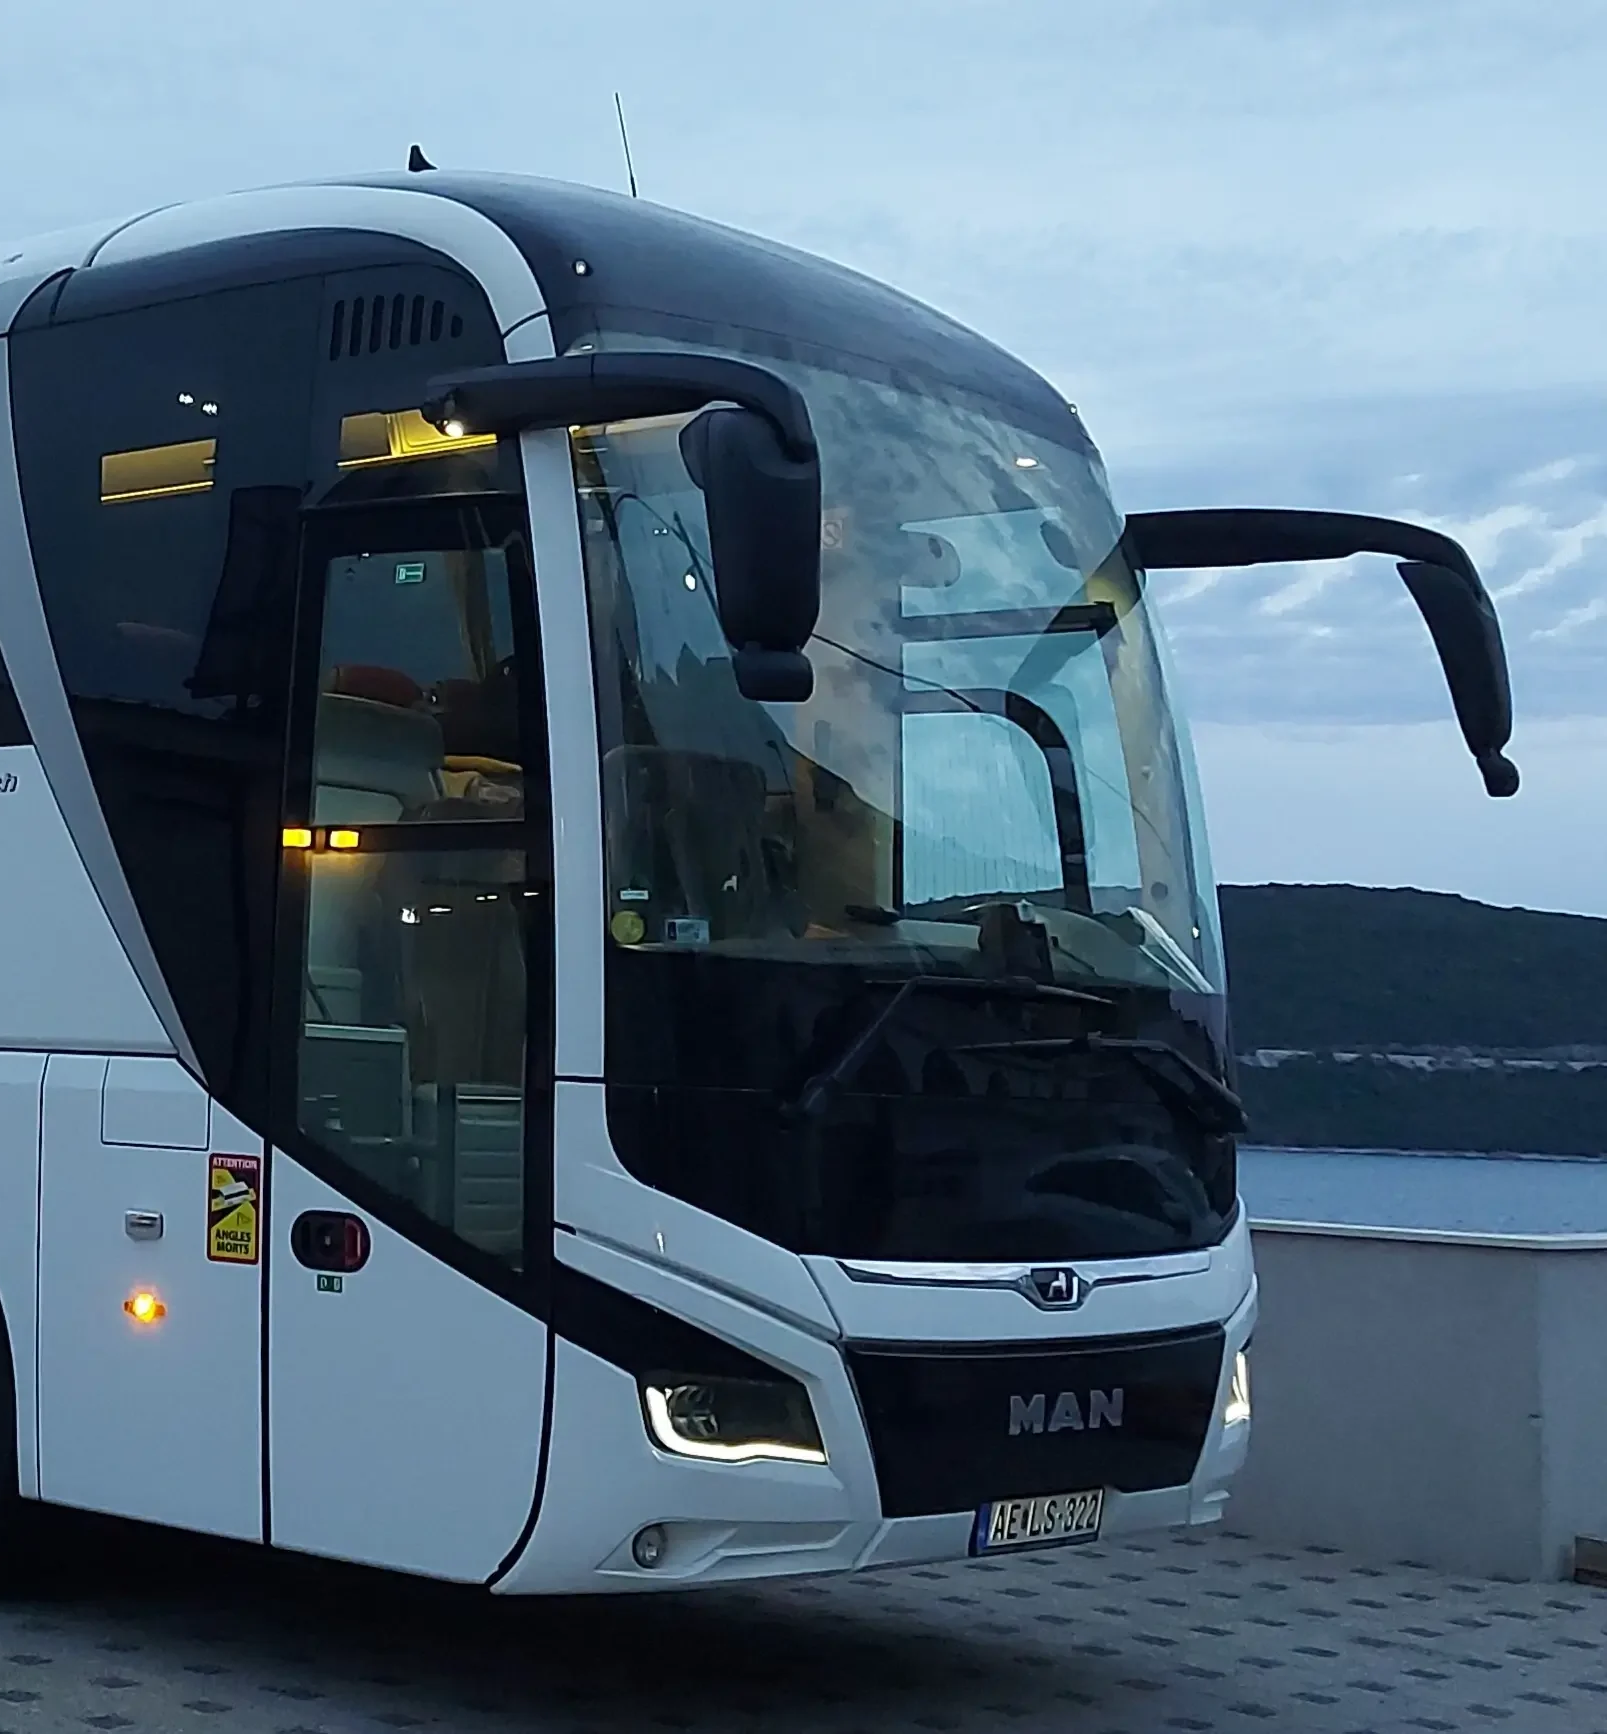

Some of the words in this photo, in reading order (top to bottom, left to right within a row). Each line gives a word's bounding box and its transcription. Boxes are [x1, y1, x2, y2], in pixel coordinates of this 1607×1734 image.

[212, 1157, 257, 1170] ATTENTION
[215, 1228, 251, 1241] ANGLES
[216, 1241, 249, 1255] MORTS
[1008, 1387, 1124, 1435] MAN
